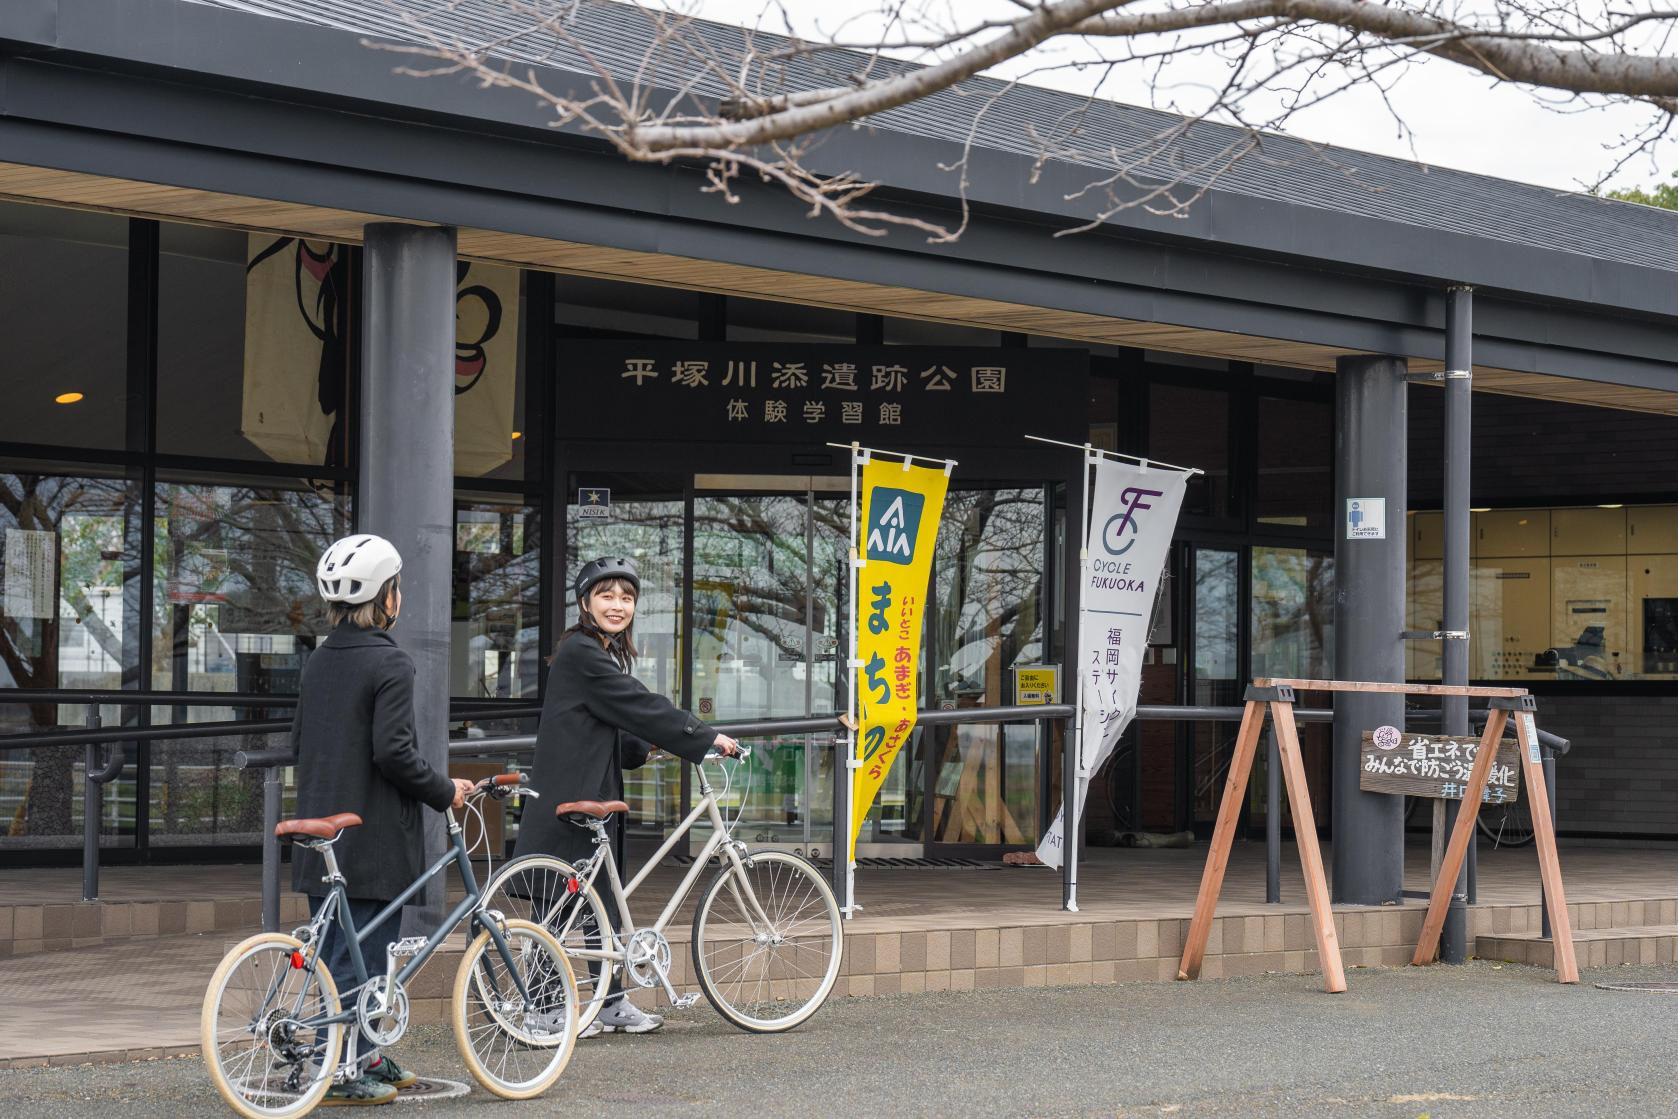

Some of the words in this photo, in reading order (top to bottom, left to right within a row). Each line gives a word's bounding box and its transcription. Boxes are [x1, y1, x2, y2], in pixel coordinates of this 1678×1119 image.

[620, 358, 1007, 393] 平塚川添遺跡公園
[726, 398, 902, 425] 体験学習館
[1093, 558, 1132, 575] CYCLE
[1090, 575, 1145, 593] FUKUOKA
[899, 595, 915, 641] いいとこ
[1408, 737, 1479, 760] 省エネで
